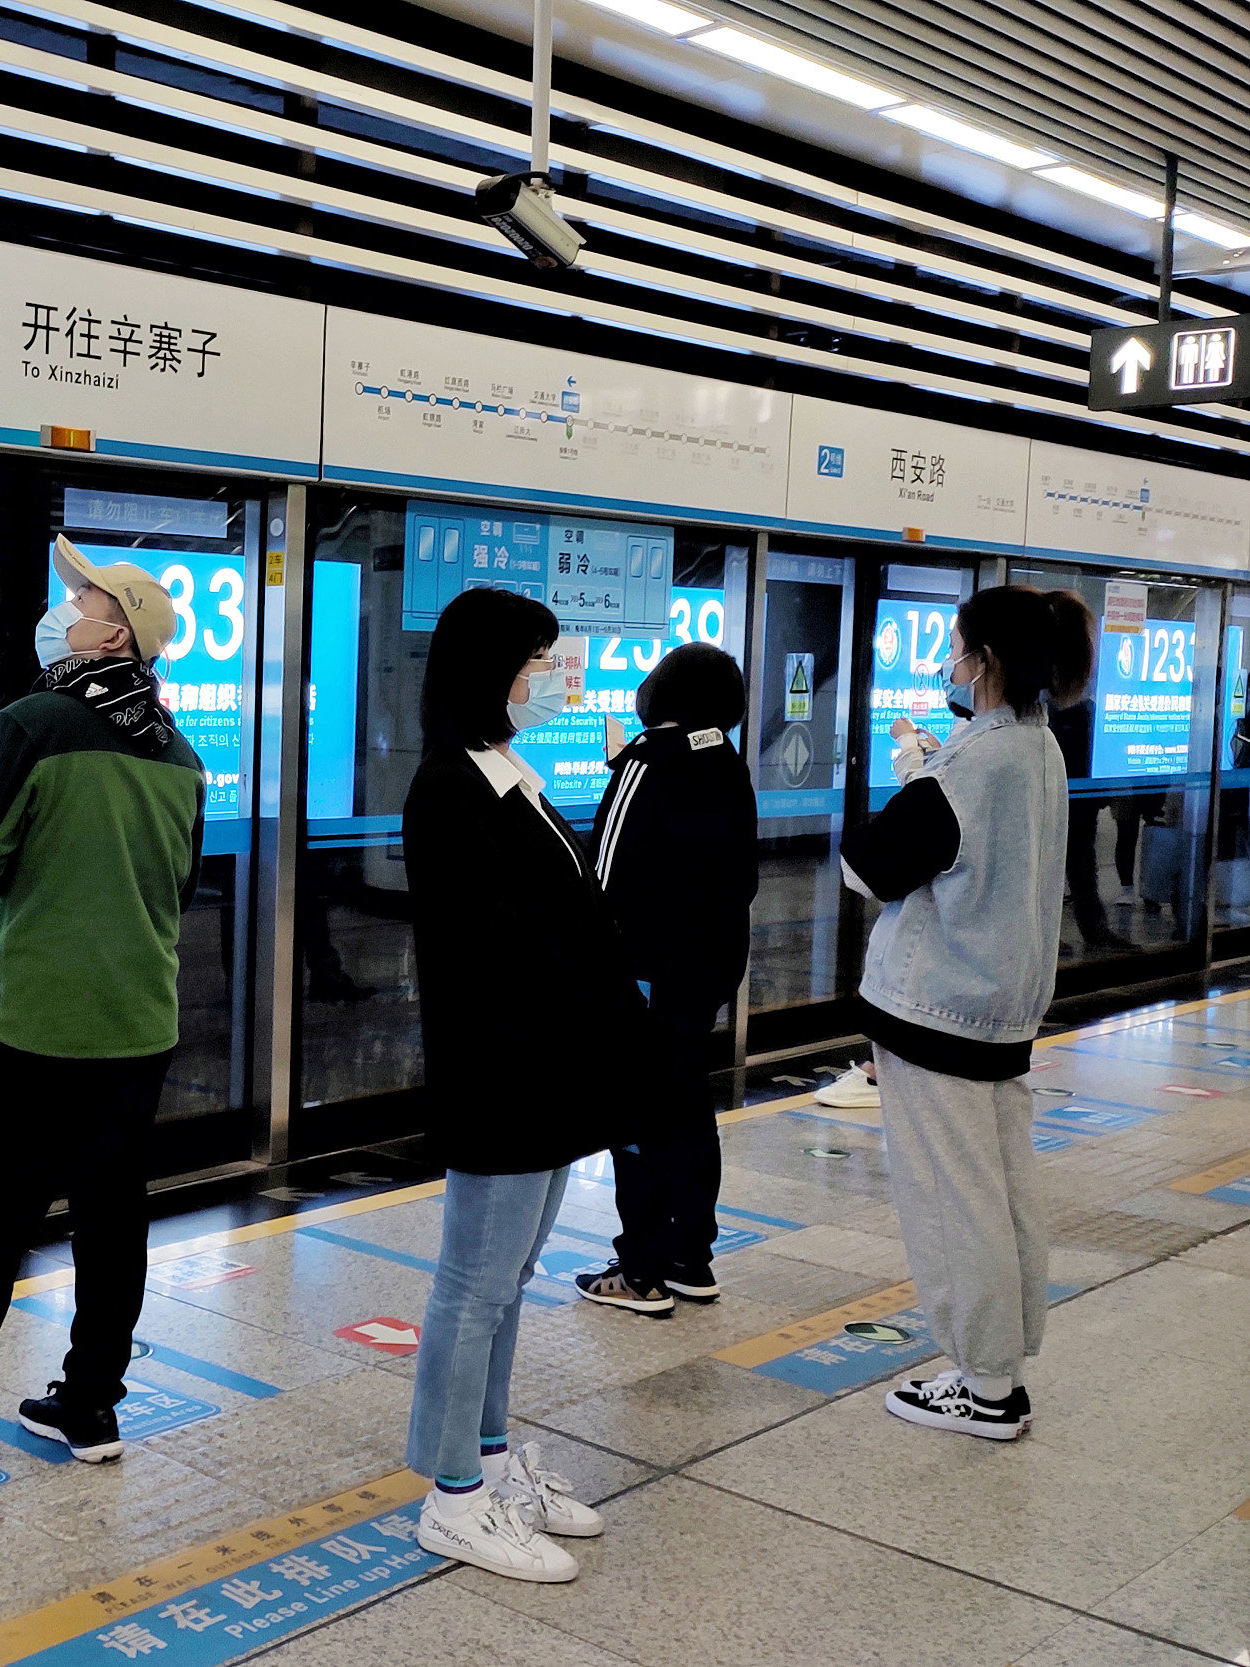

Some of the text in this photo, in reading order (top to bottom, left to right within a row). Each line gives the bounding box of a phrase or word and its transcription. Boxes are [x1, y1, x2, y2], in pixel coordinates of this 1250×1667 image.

[22, 302, 221, 378] 开往辛寨子
[22, 360, 120, 390] To Xinzhaizi
[890, 448, 946, 488] 西安路
[898, 487, 934, 503] Xi'an Road
[480, 520, 503, 538] 空调
[564, 529, 584, 545] 空调
[473, 544, 509, 571] 强冷
[558, 552, 590, 576] 弱冷
[186, 715, 235, 727] for citizens
[428, 1518, 474, 1551] DREAM
[162, 1574, 197, 1591] WAIT
[206, 1549, 261, 1574] OUTSIDE
[224, 1600, 309, 1639] Please
[303, 1578, 361, 1605] Line
[358, 1565, 391, 1583] up
